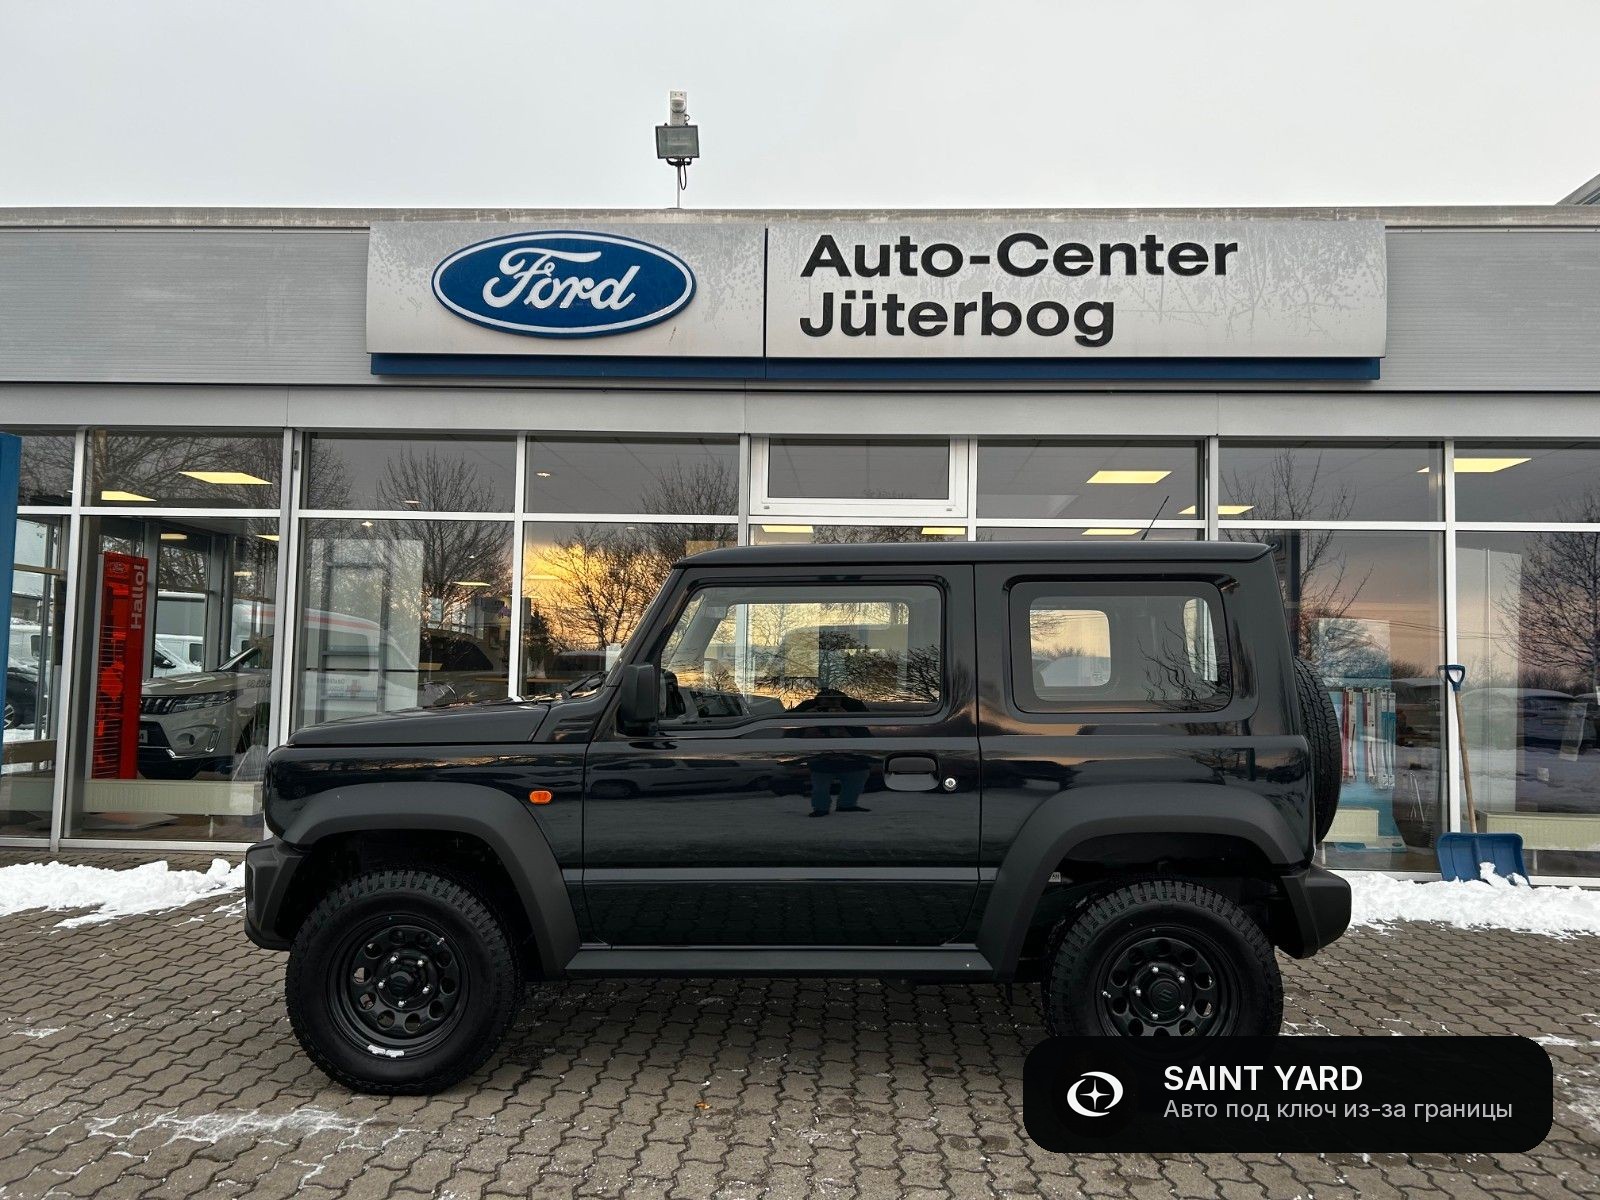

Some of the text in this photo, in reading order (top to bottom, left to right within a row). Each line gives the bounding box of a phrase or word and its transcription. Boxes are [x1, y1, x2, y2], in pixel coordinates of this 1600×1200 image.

[482, 247, 641, 311] Ford
[800, 232, 1238, 278] Auto-Center
[799, 290, 1115, 348] Jüterbog
[131, 564, 145, 630] Hallo!
